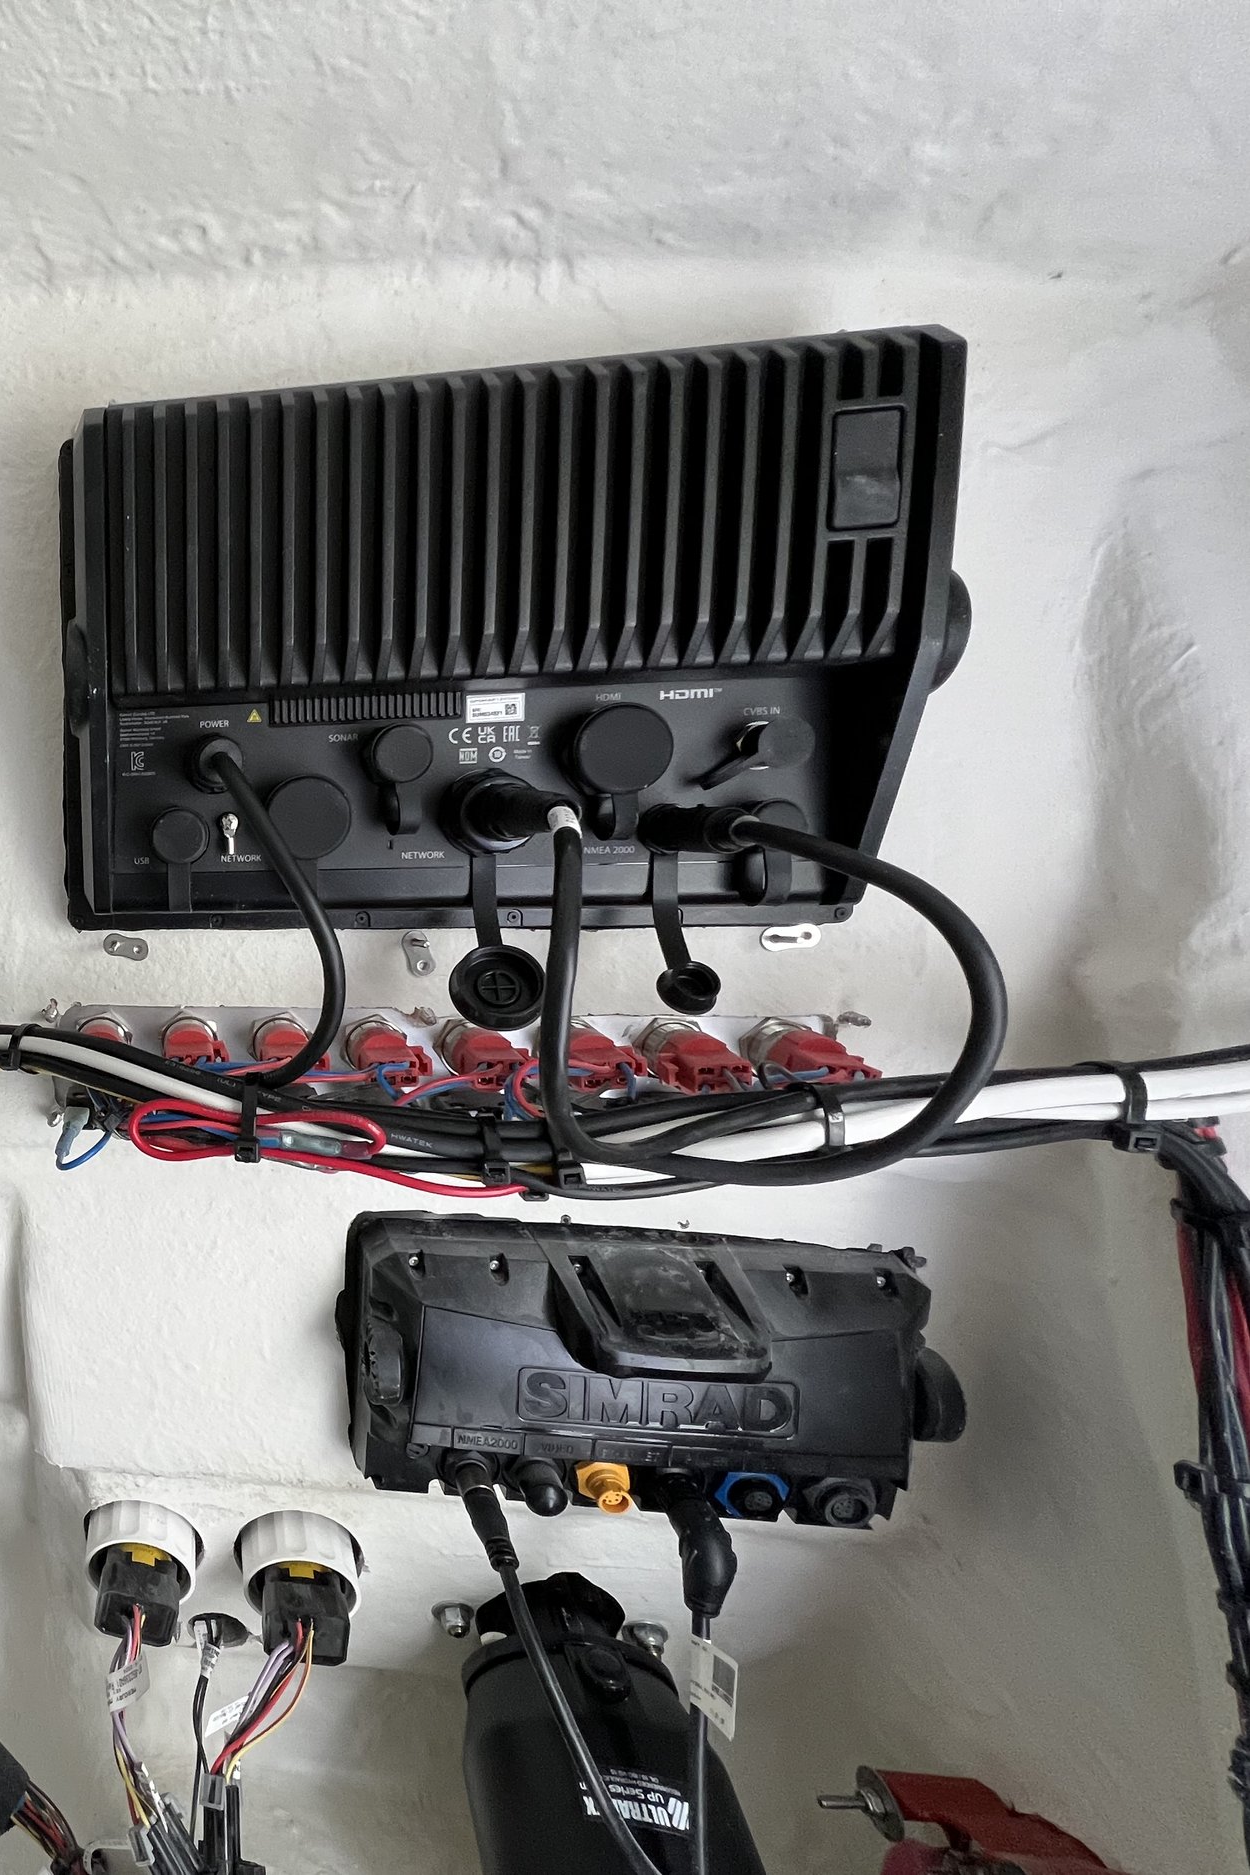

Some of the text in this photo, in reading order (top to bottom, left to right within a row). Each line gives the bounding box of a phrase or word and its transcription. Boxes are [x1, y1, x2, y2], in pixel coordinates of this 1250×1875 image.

[595, 692, 621, 702] HDMI
[743, 706, 781, 716] CVBS IN
[200, 719, 229, 729] POWER
[328, 733, 359, 743] SONAR
[401, 850, 446, 860] NETWORK
[583, 845, 635, 855] NMEA 2000
[134, 856, 150, 865] USB
[220, 854, 262, 864] NETWORK
[525, 1372, 792, 1431] SIMRAD
[457, 1434, 519, 1449] NMEA2000
[608, 1784, 645, 1799] Series
[647, 1791, 665, 1804] UP
